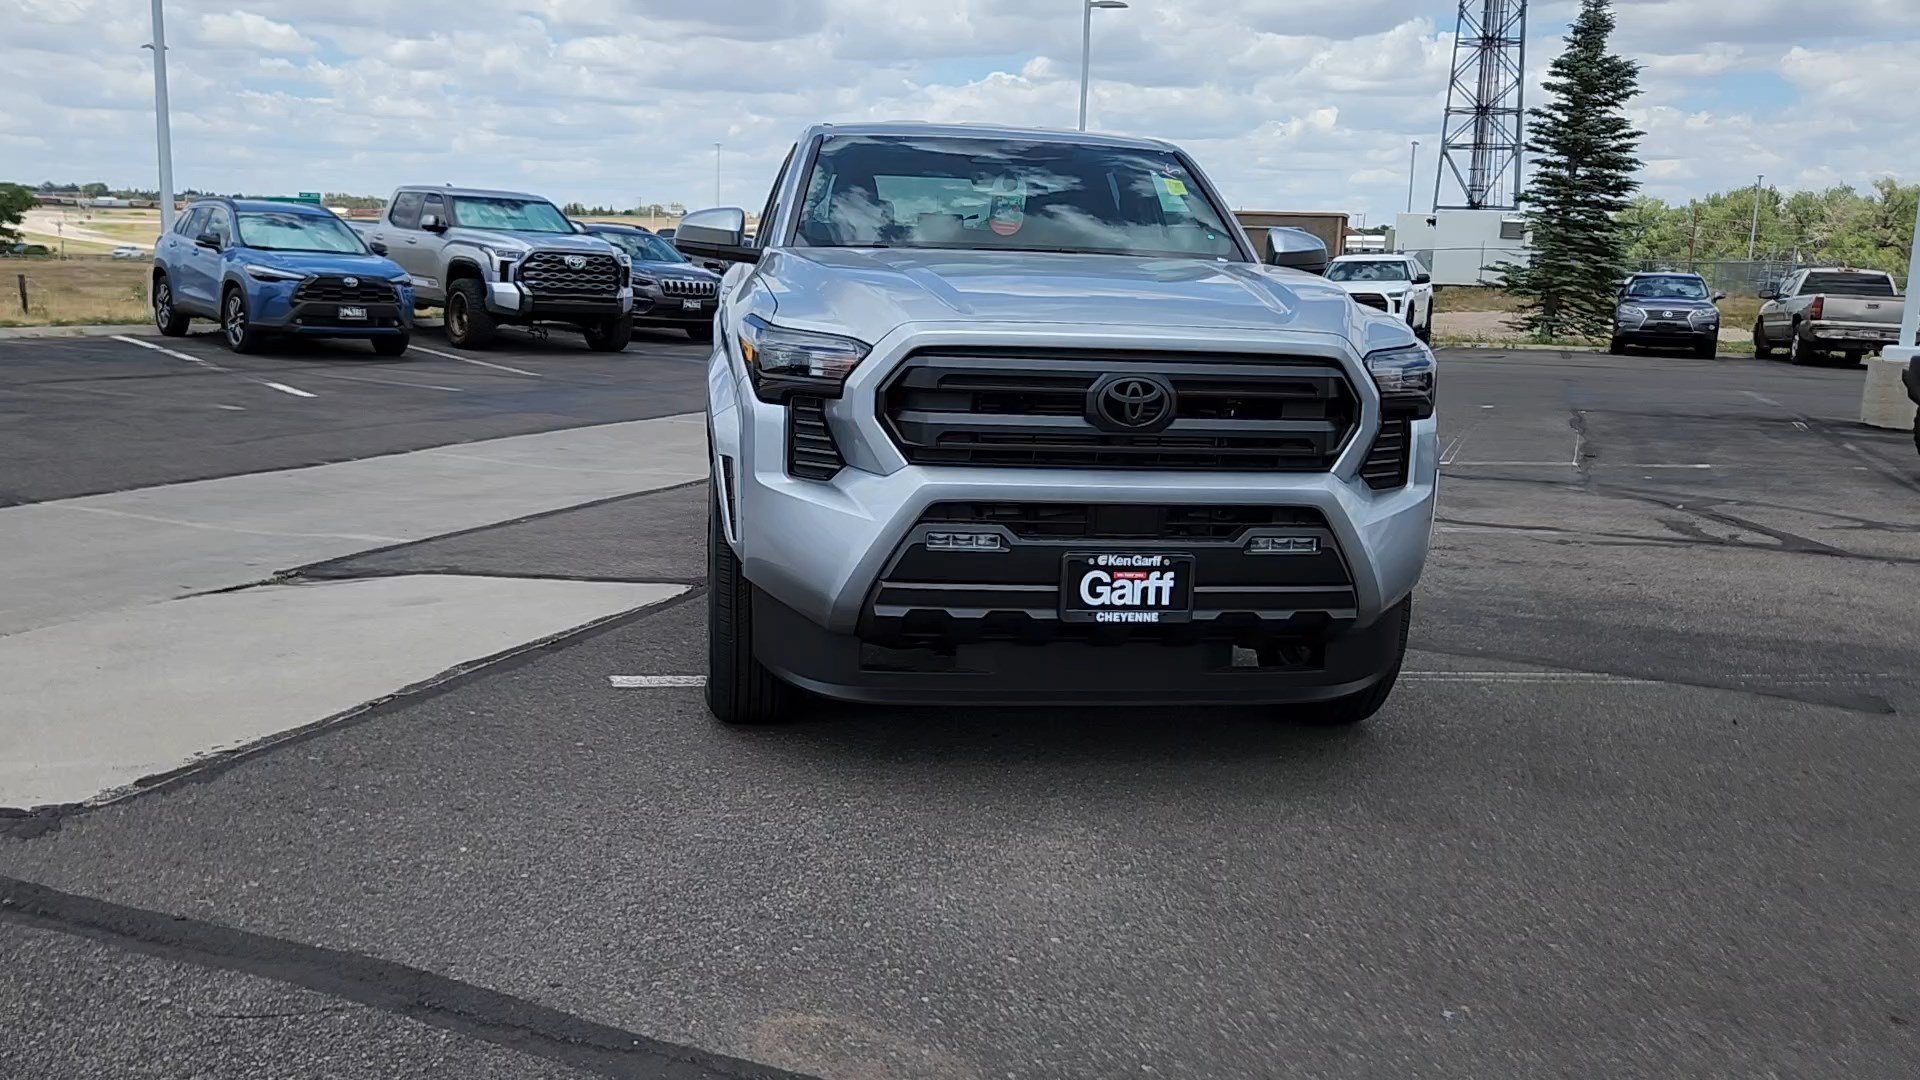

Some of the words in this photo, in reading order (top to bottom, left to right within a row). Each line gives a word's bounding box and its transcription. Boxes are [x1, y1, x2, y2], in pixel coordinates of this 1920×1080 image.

[1108, 555, 1131, 567] Ken
[1132, 555, 1162, 567] Garff
[1079, 570, 1175, 606] Garff
[1096, 612, 1159, 622] CHEYENNE
